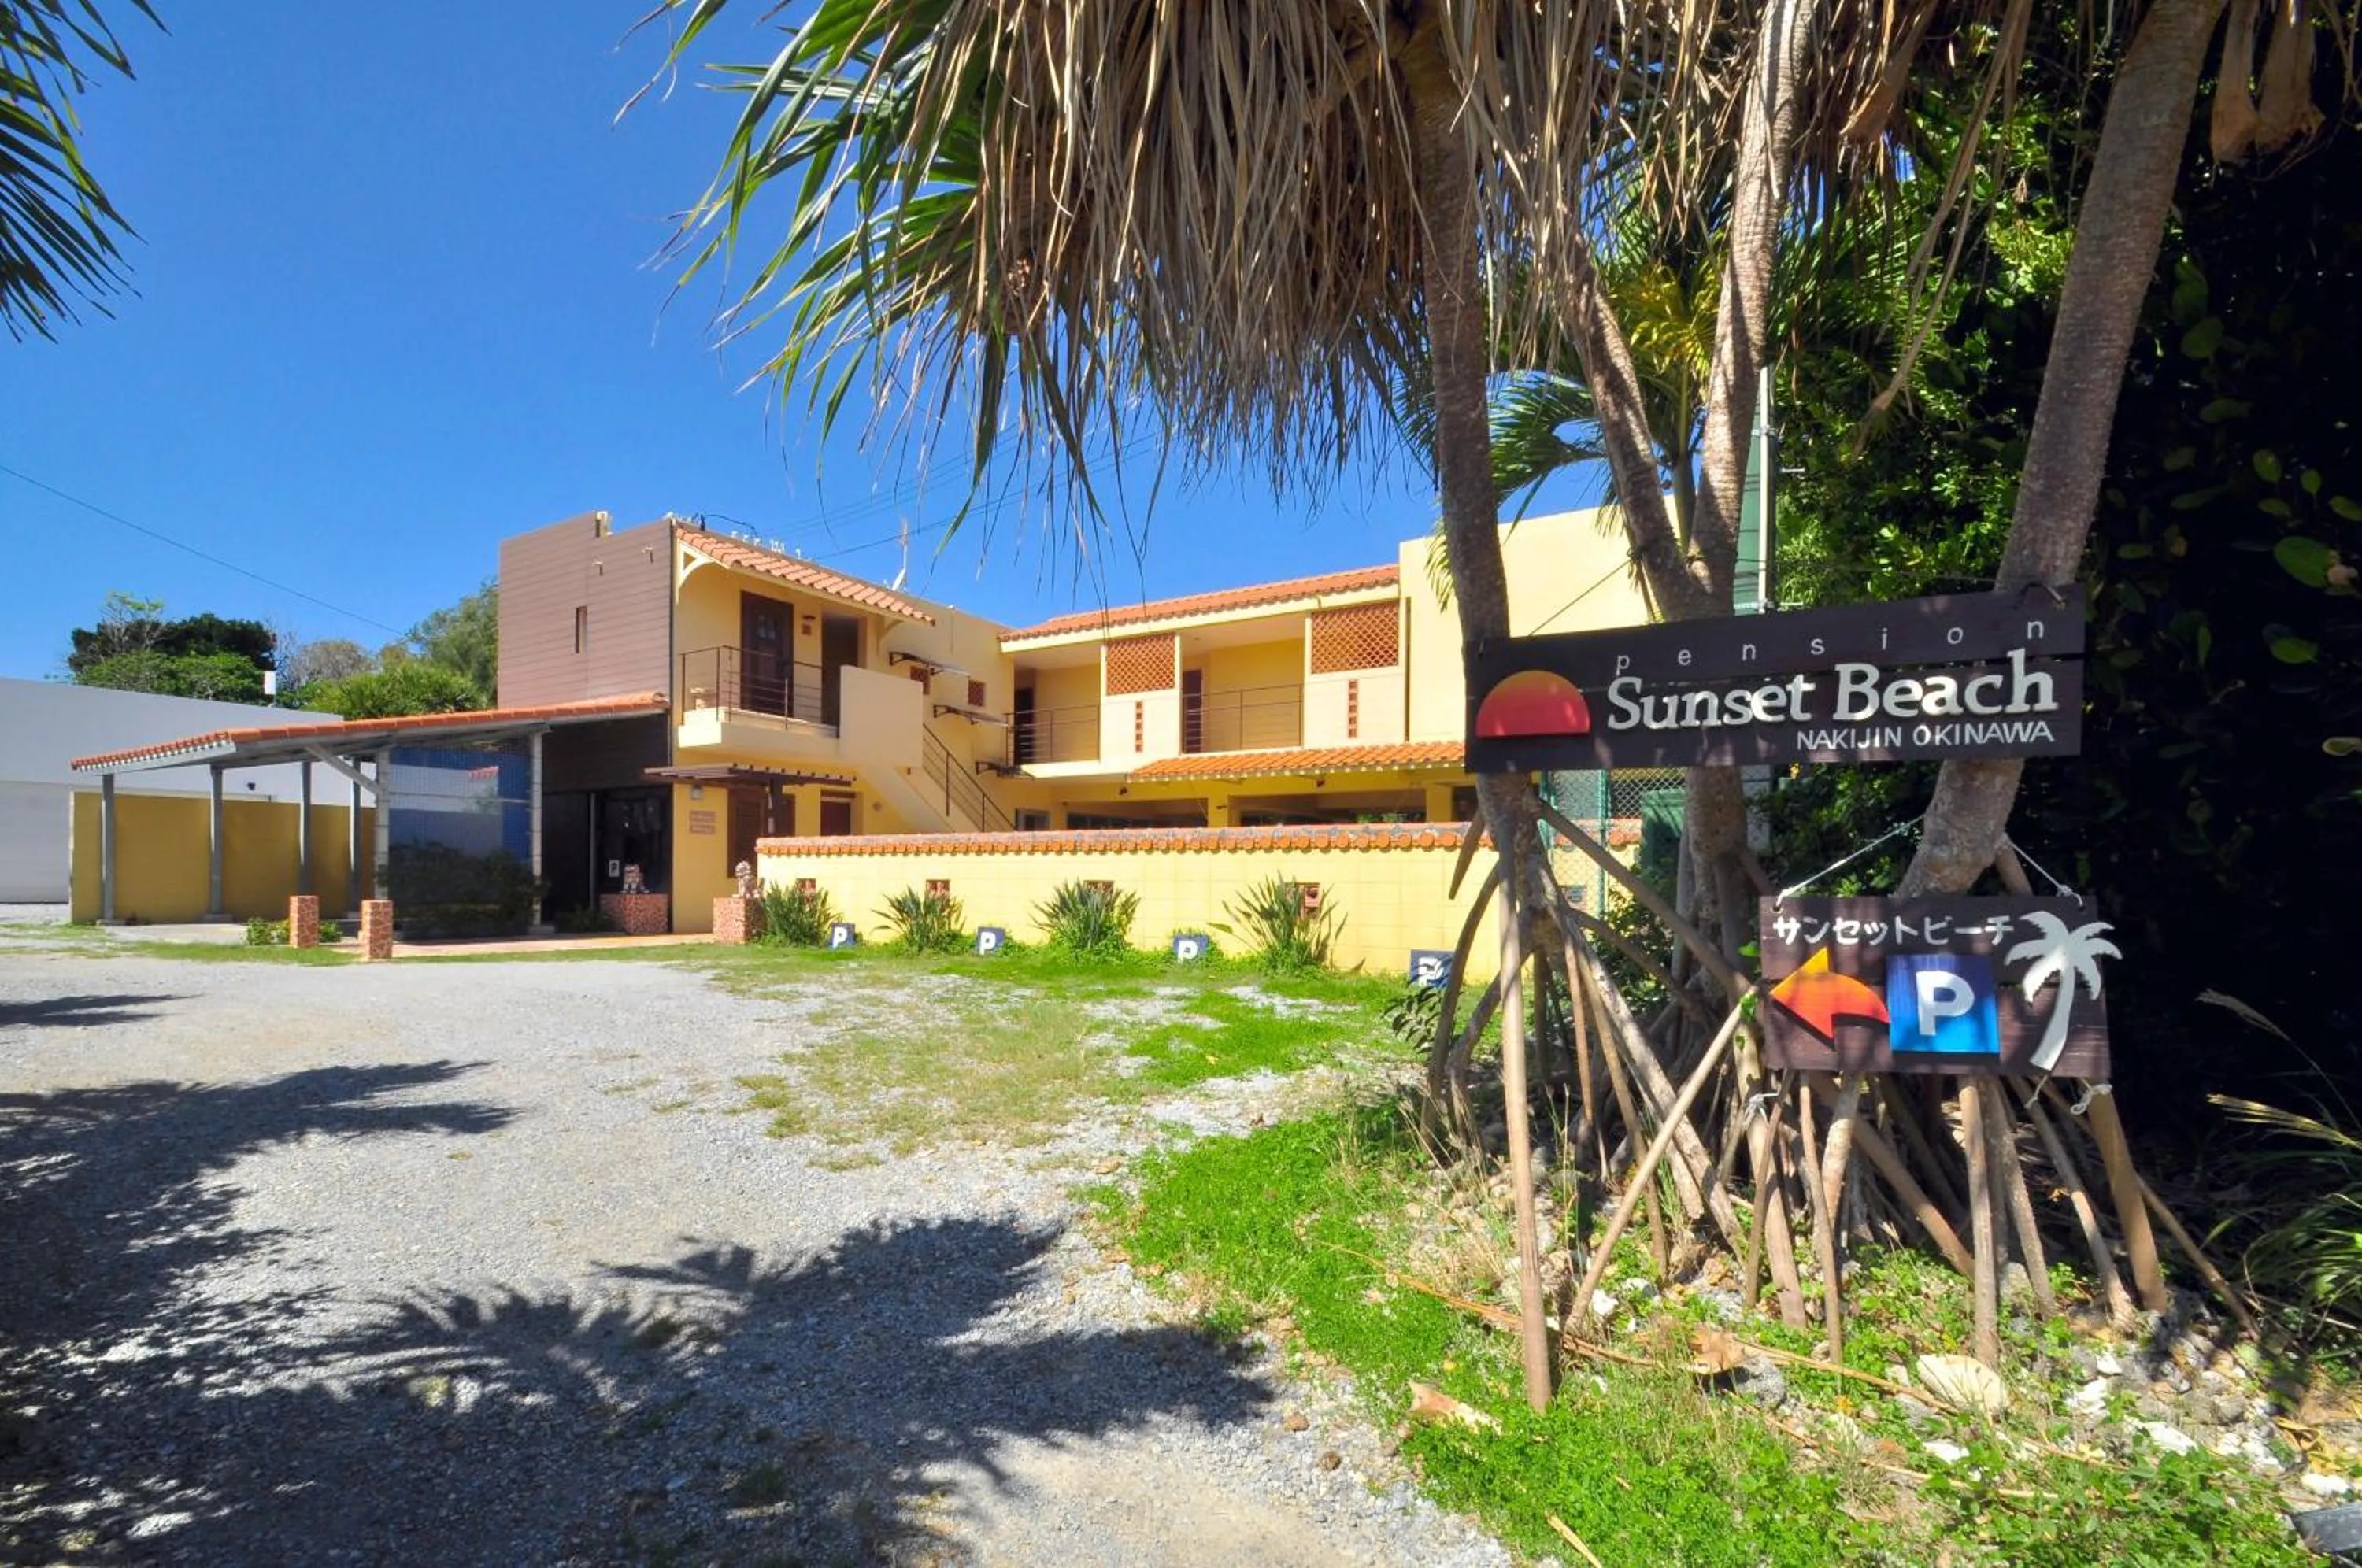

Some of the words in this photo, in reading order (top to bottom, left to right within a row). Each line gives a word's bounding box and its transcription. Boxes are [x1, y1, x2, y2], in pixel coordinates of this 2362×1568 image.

[1616, 620, 2045, 676] pension
[1607, 673, 1816, 730] Sunset
[1832, 648, 2059, 722] Beach
[1797, 727, 1902, 750] NAKIJIN
[1912, 721, 2054, 747] OKINAWA
[833, 926, 848, 949] P
[979, 931, 996, 956] P
[1773, 915, 2014, 945] サンセットビーチ
[1178, 940, 1198, 964] P
[1915, 970, 1975, 1037] P
